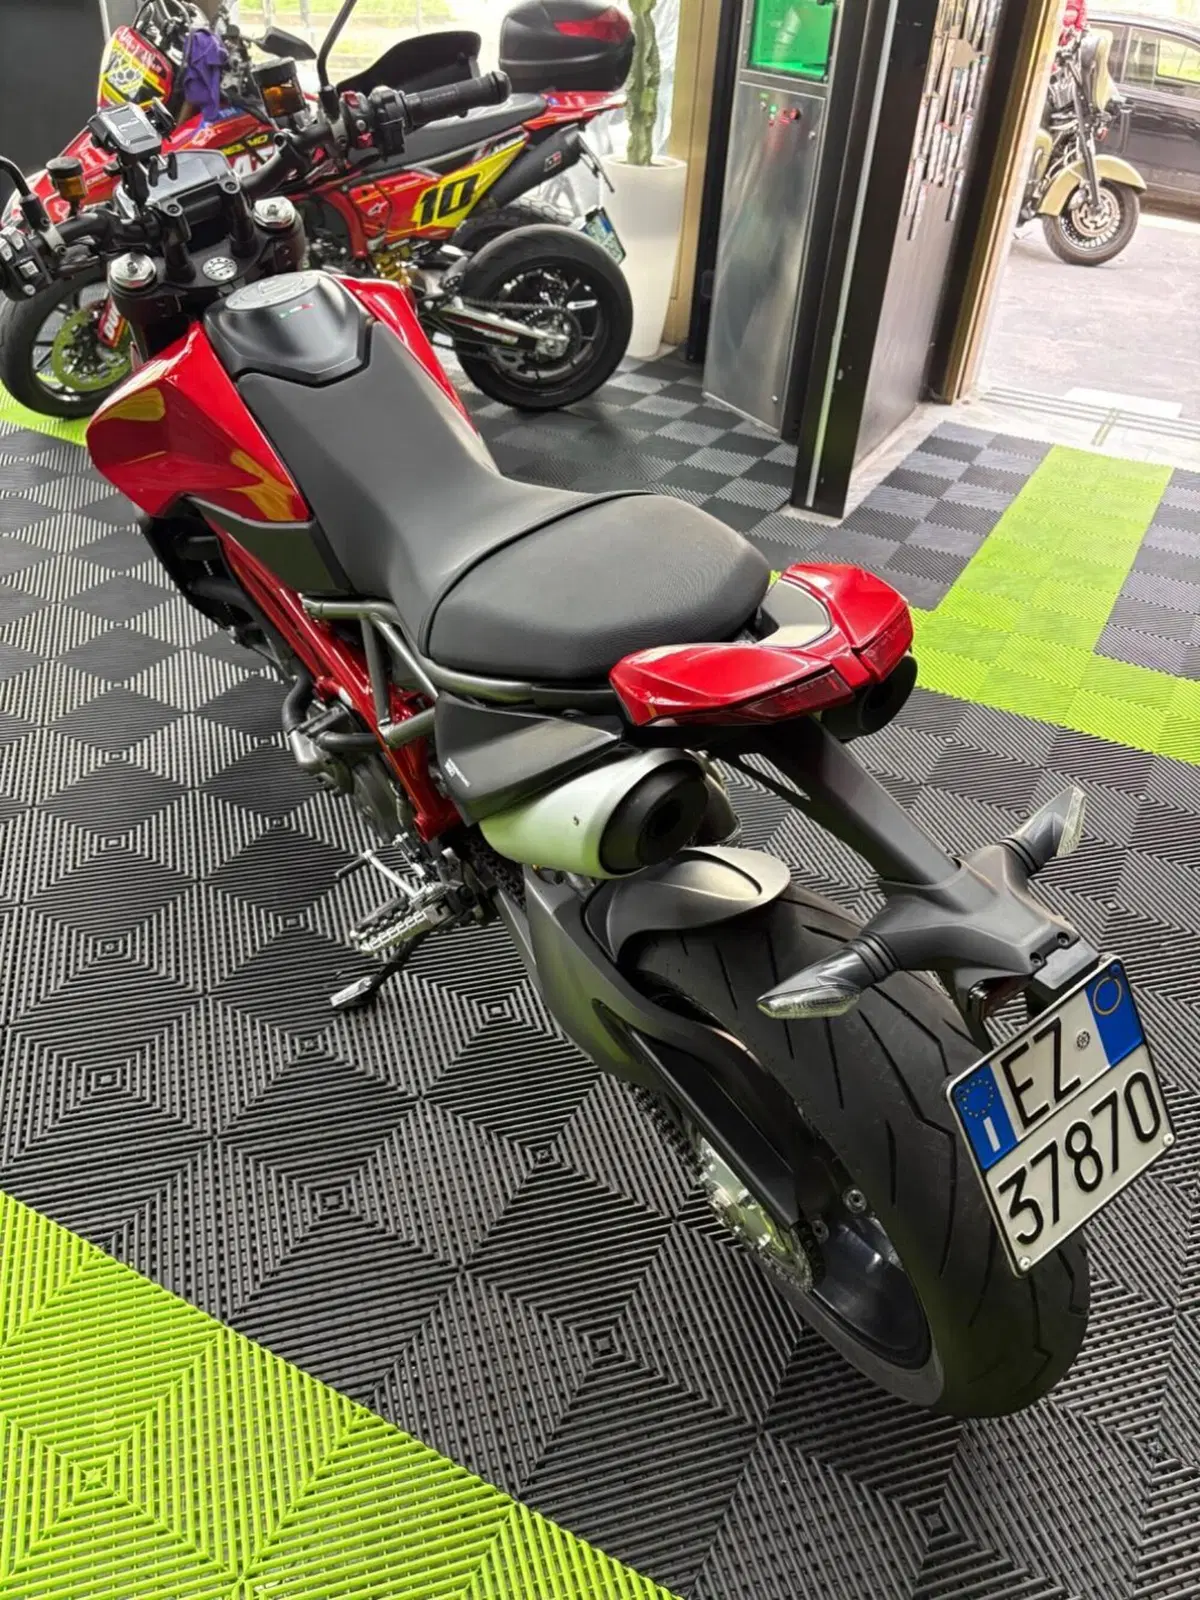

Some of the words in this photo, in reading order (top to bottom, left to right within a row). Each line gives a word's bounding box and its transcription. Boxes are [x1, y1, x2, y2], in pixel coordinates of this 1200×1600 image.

[420, 173, 481, 226] 10
[1000, 1016, 1082, 1131] EZ
[996, 1071, 1162, 1246] 37870
